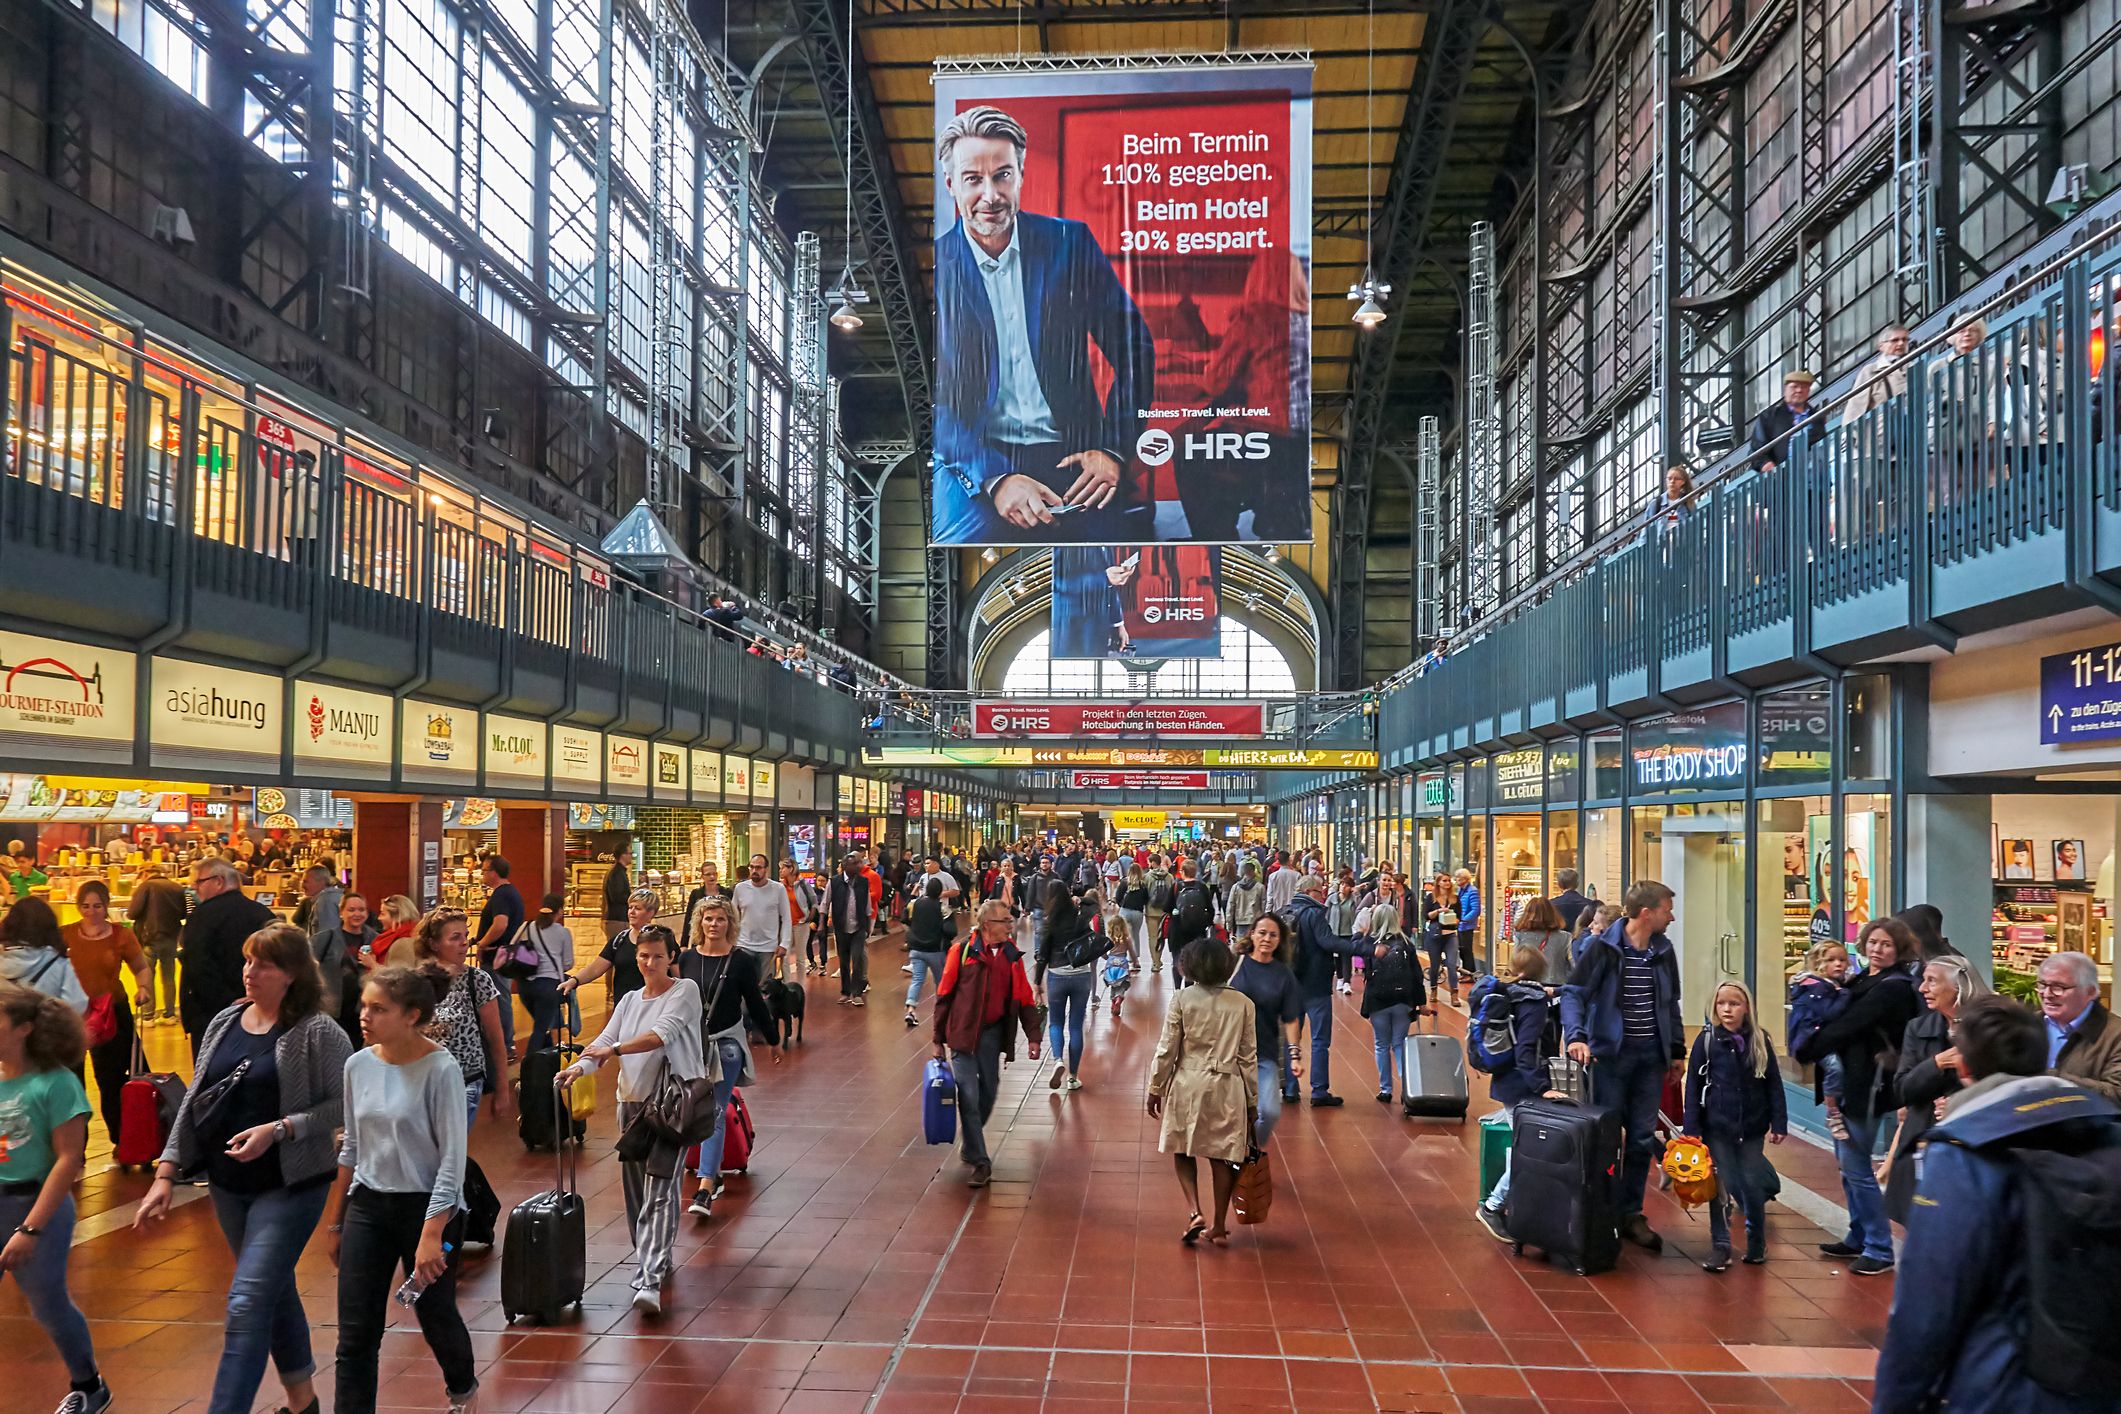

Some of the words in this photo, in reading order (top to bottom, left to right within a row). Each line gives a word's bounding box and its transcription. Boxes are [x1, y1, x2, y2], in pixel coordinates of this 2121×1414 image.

[1123, 132, 1181, 155] Beim
[1189, 130, 1269, 153] Termin
[1102, 163, 1161, 185] 110%
[1169, 160, 1272, 187] gegeben.
[1137, 199, 1197, 221] Beim
[1205, 197, 1268, 220] Hotel
[1120, 230, 1169, 252] 30%
[1176, 227, 1273, 254] gespart.
[1137, 409, 1180, 418] Business
[1181, 408, 1214, 417] Travel.
[1216, 408, 1240, 417] Next
[1241, 407, 1271, 416] Level.
[268, 419, 285, 438] 365
[1185, 432, 1271, 460] HRS
[1165, 608, 1205, 621] HRS
[0, 693, 104, 718] OURMET-STATION
[166, 682, 265, 729] asiahung
[1082, 709, 1114, 719] Projekt
[1117, 709, 1125, 718] in
[1127, 709, 1144, 718] den
[1146, 709, 1176, 719] letzten
[1178, 709, 1208, 720] Zügen.
[2070, 706, 2082, 718] zu
[2083, 703, 2100, 716] den
[330, 709, 379, 740] MANJU
[1012, 717, 1050, 729] HRS
[1082, 720, 1143, 731] Hotelbuchung
[1145, 720, 1154, 729] in
[1156, 720, 1186, 730] besten
[1188, 720, 1225, 730] Händen.
[1638, 756, 1662, 784] THE
[1665, 750, 1703, 782] BODY
[1705, 744, 1747, 778] SHOP
